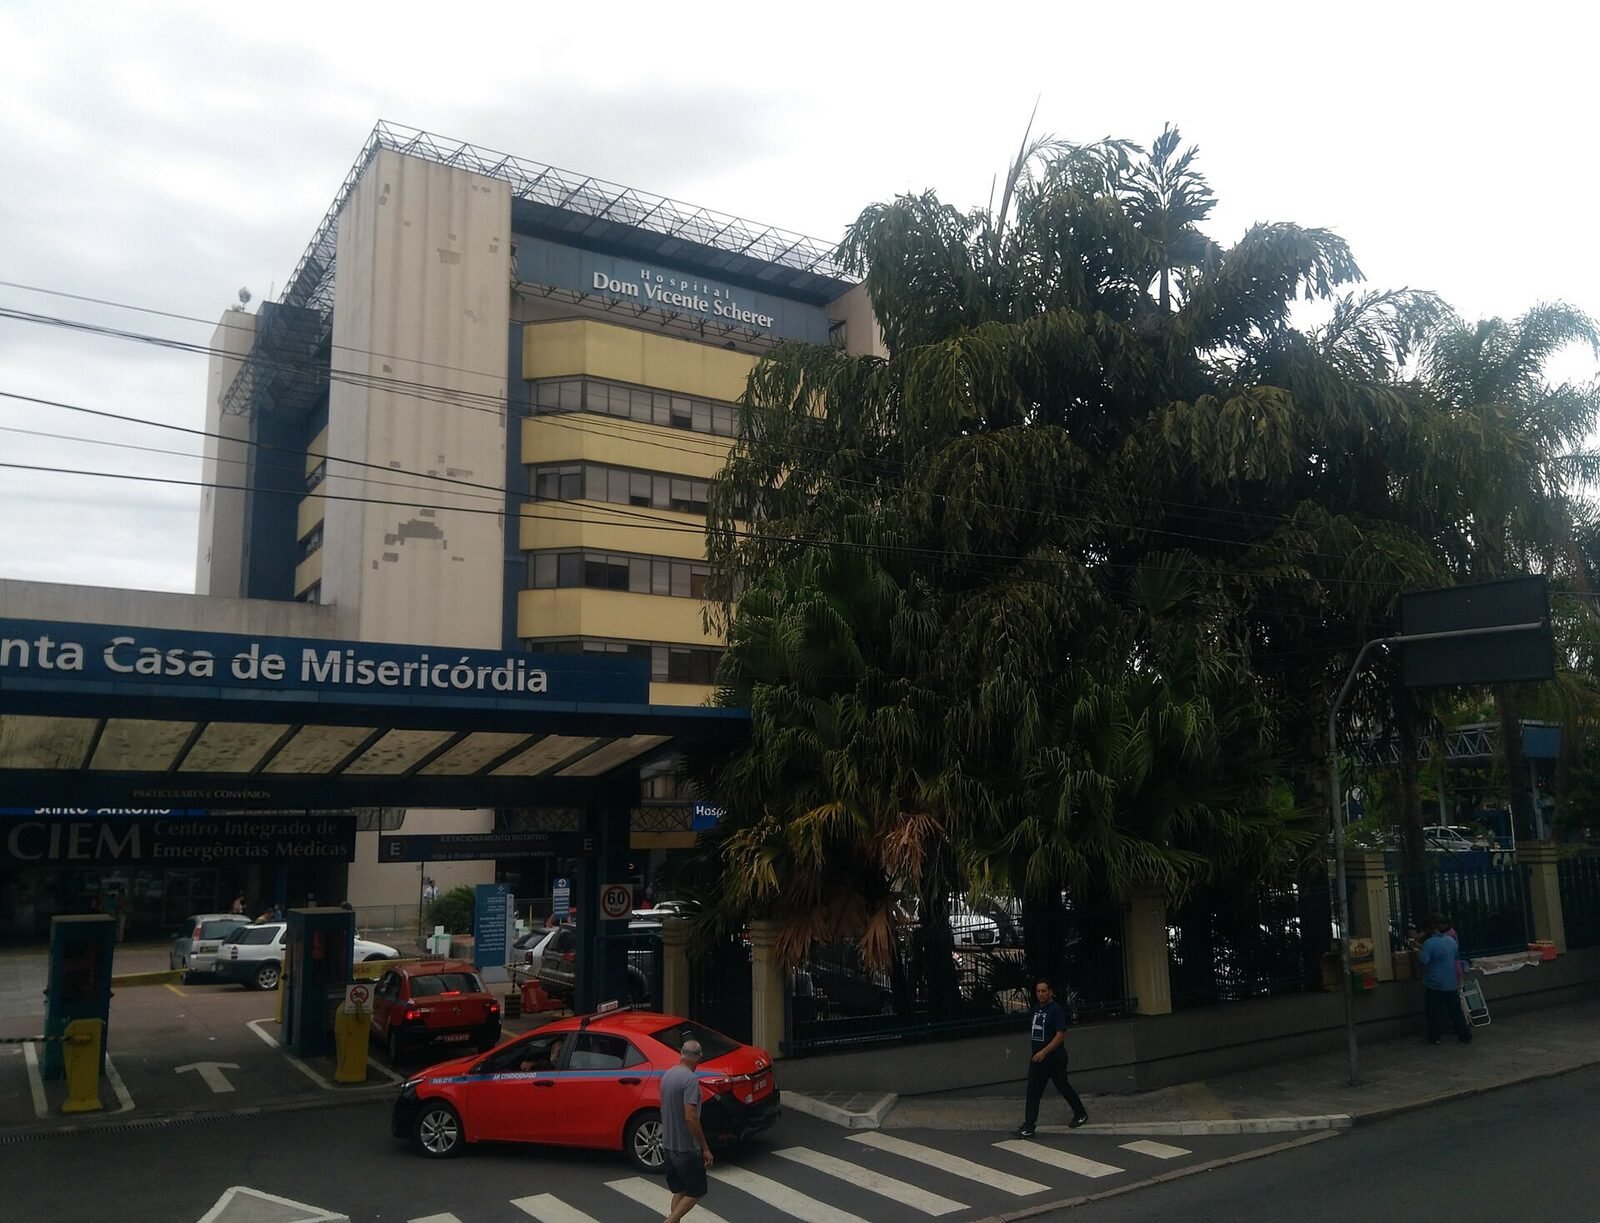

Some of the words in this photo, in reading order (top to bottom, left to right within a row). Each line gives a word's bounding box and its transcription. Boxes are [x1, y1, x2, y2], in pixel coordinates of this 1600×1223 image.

[592, 271, 639, 297] Dom
[643, 281, 710, 312] Vicente
[713, 299, 774, 329] Scherer
[639, 268, 731, 300] Hospital
[103, 636, 214, 678] Casa
[231, 643, 287, 681] de
[301, 647, 549, 694] Misericórdia
[132, 788, 205, 799] PARTICULARES
[213, 787, 272, 799] CONVÊNIOS
[7, 821, 142, 861] CIEM
[153, 819, 219, 837] Centro
[224, 819, 313, 839] Integrado
[316, 819, 338, 836] de
[152, 841, 269, 863] Emergências
[274, 840, 348, 857] Médicas
